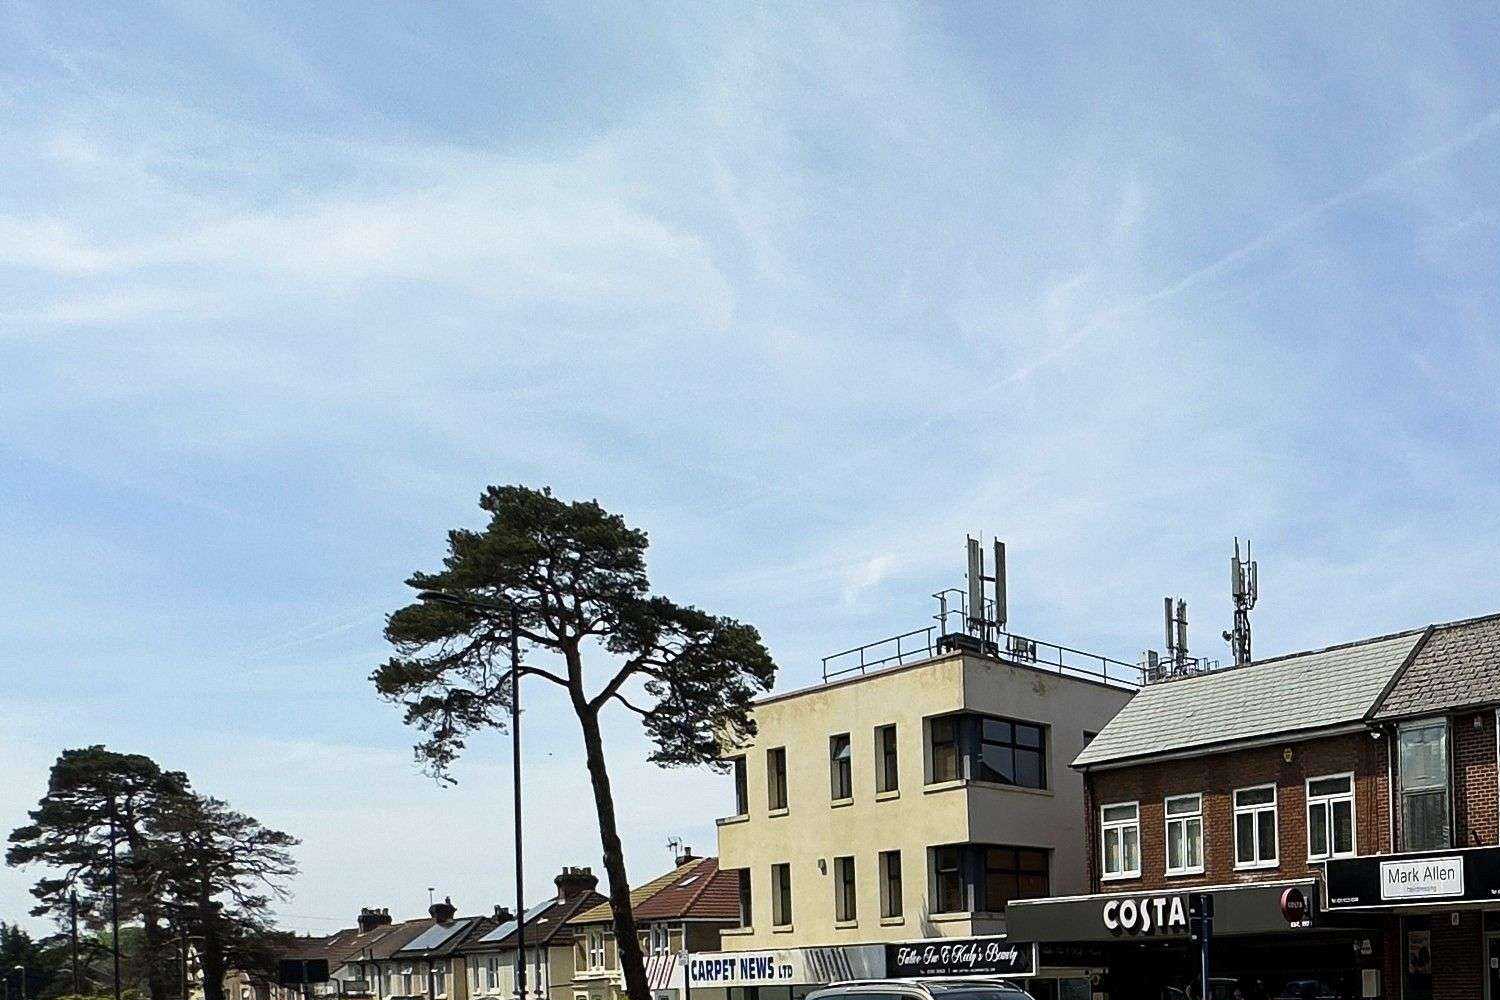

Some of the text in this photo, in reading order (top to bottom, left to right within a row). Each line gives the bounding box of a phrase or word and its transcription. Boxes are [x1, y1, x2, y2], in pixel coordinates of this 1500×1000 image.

[1388, 865, 1455, 884] Mark Allen
[1103, 897, 1187, 932] COSTA
[897, 946, 921, 966] Tattoo
[985, 942, 1018, 966] Beauty
[691, 958, 737, 982] CARPET
[740, 956, 775, 980] NEWS
[779, 964, 793, 979] LTD
